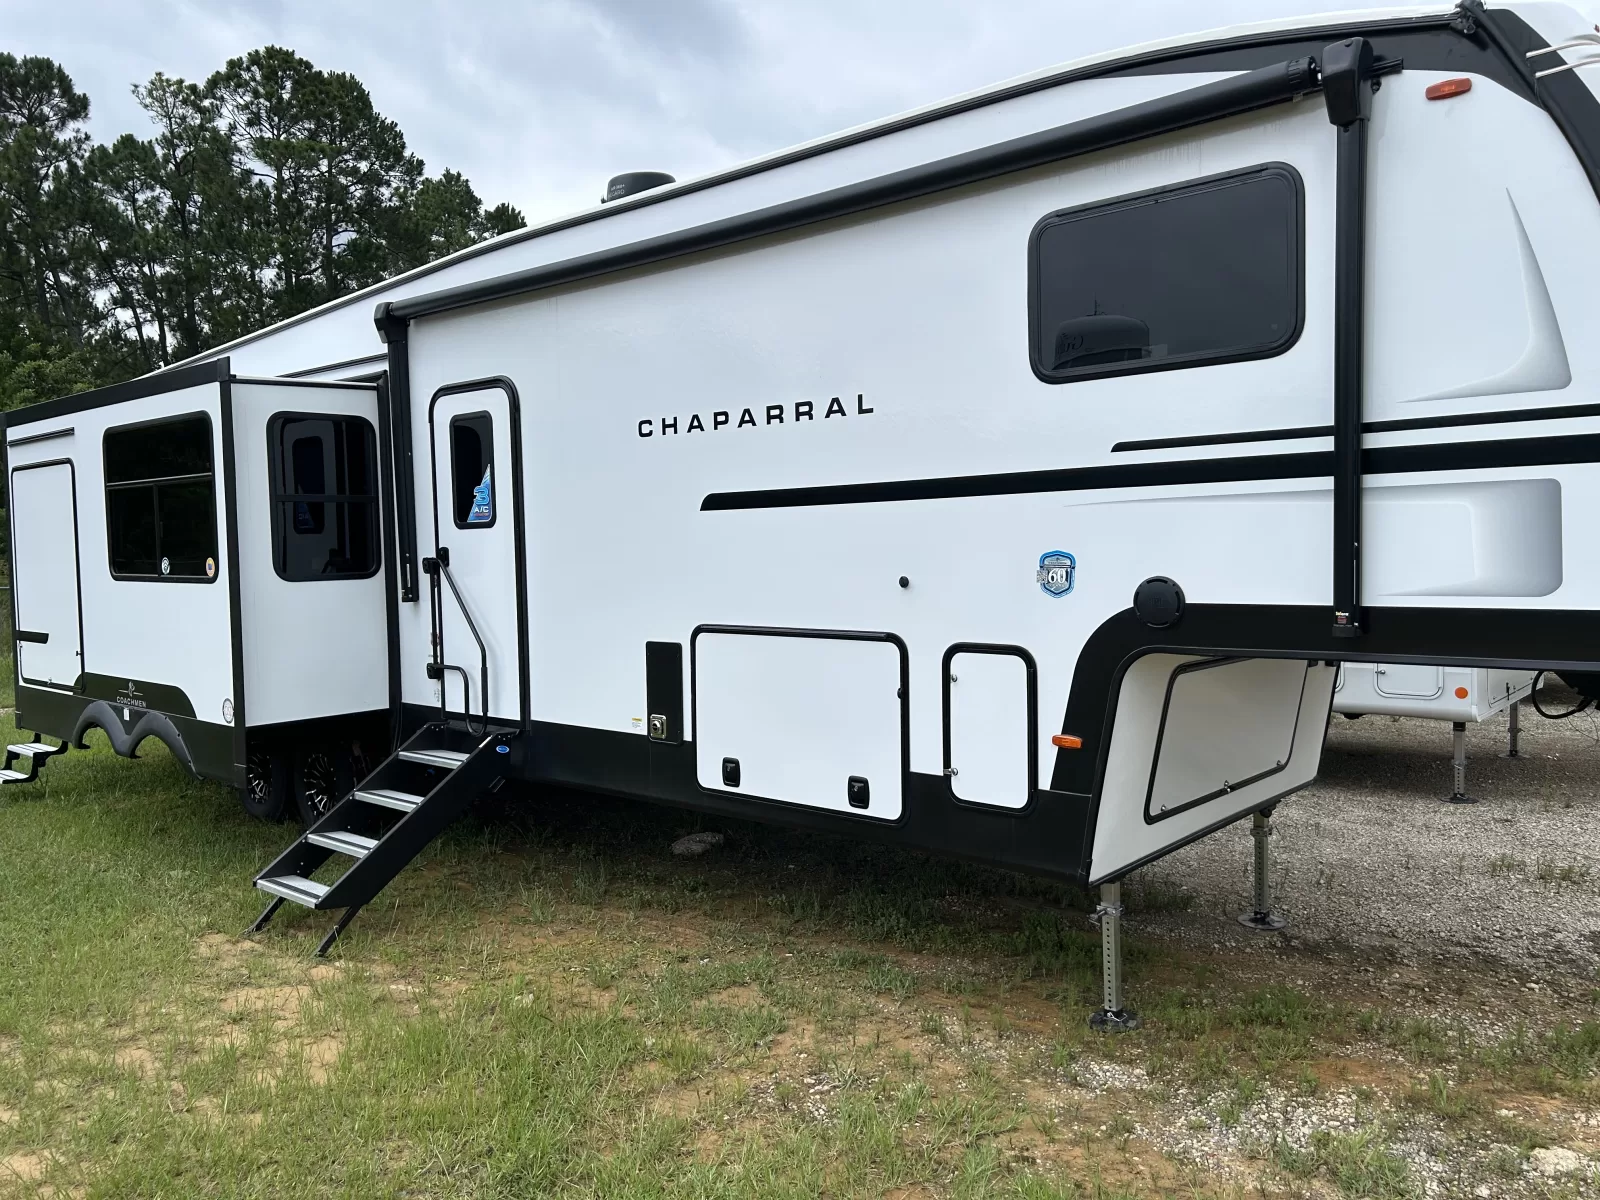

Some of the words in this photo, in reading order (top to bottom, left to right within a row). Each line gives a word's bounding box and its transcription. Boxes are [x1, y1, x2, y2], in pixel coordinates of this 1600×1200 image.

[638, 393, 874, 437] CHAPARRAL
[473, 486, 490, 505] 3
[1048, 568, 1067, 584] 60
[116, 696, 147, 708] COACHMEN
